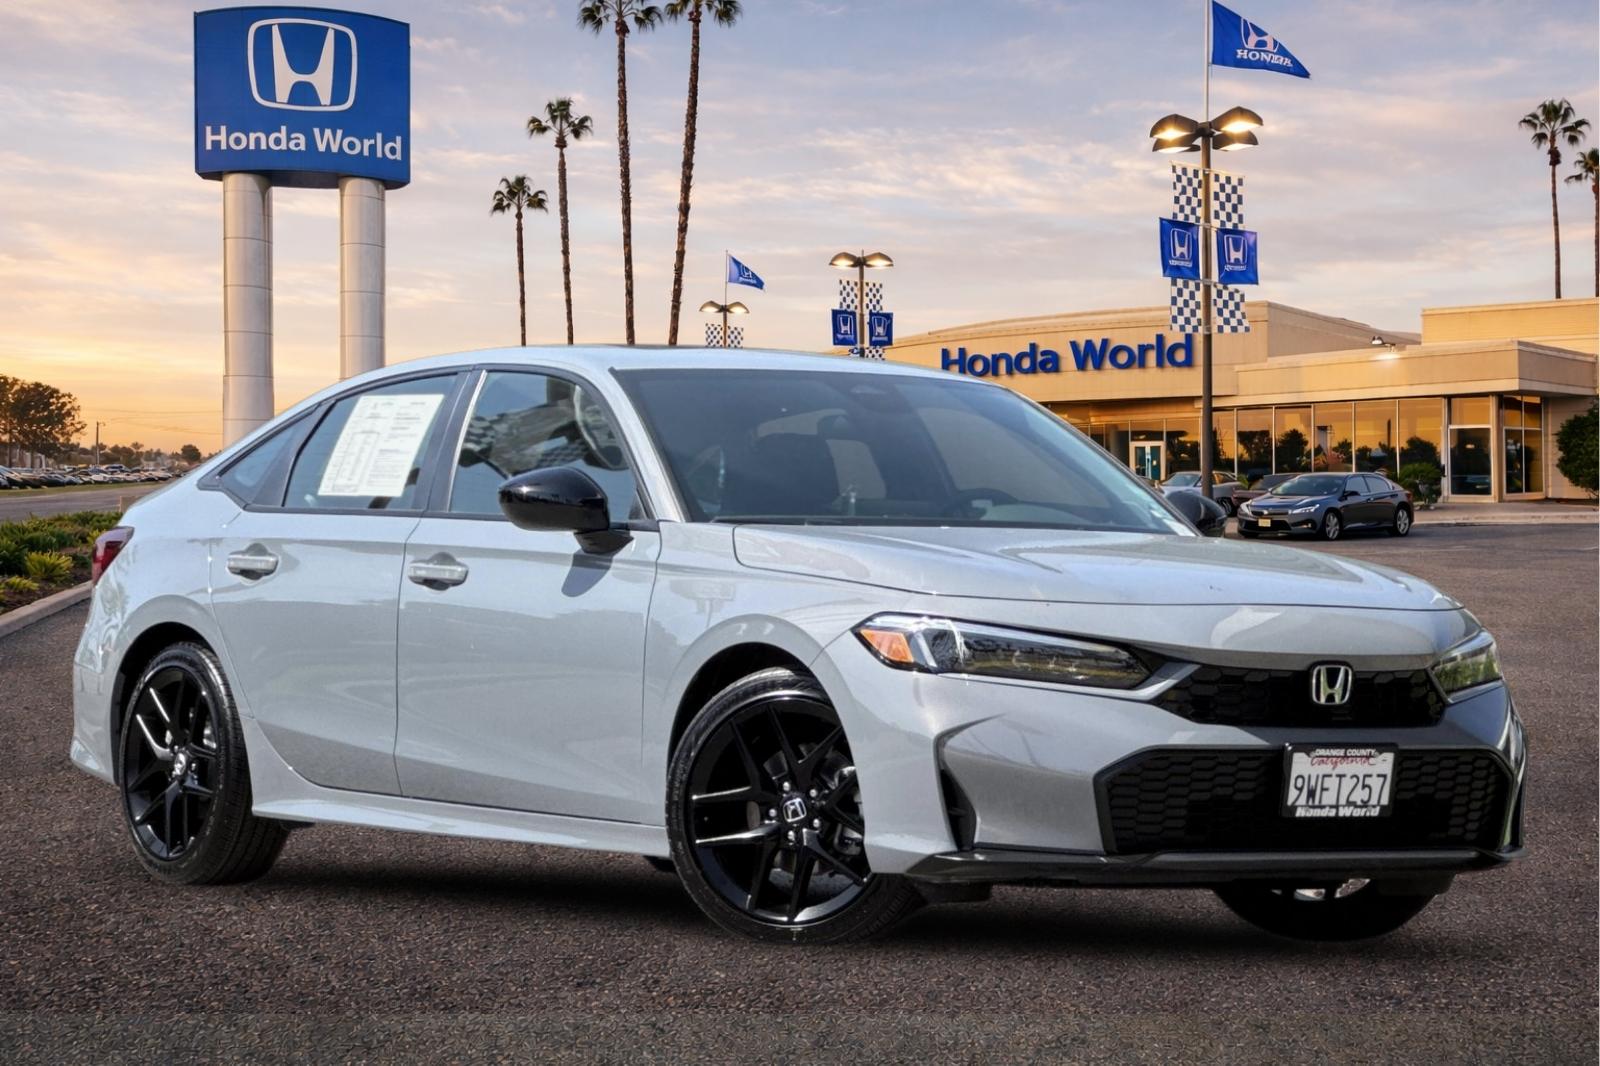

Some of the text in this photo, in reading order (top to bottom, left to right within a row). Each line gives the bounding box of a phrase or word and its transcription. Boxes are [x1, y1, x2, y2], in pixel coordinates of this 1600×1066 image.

[205, 125, 402, 161] Honda World
[941, 333, 1193, 377] Honda World
[1292, 773, 1388, 806] 9WFT257
[1295, 805, 1381, 818] Honda World
